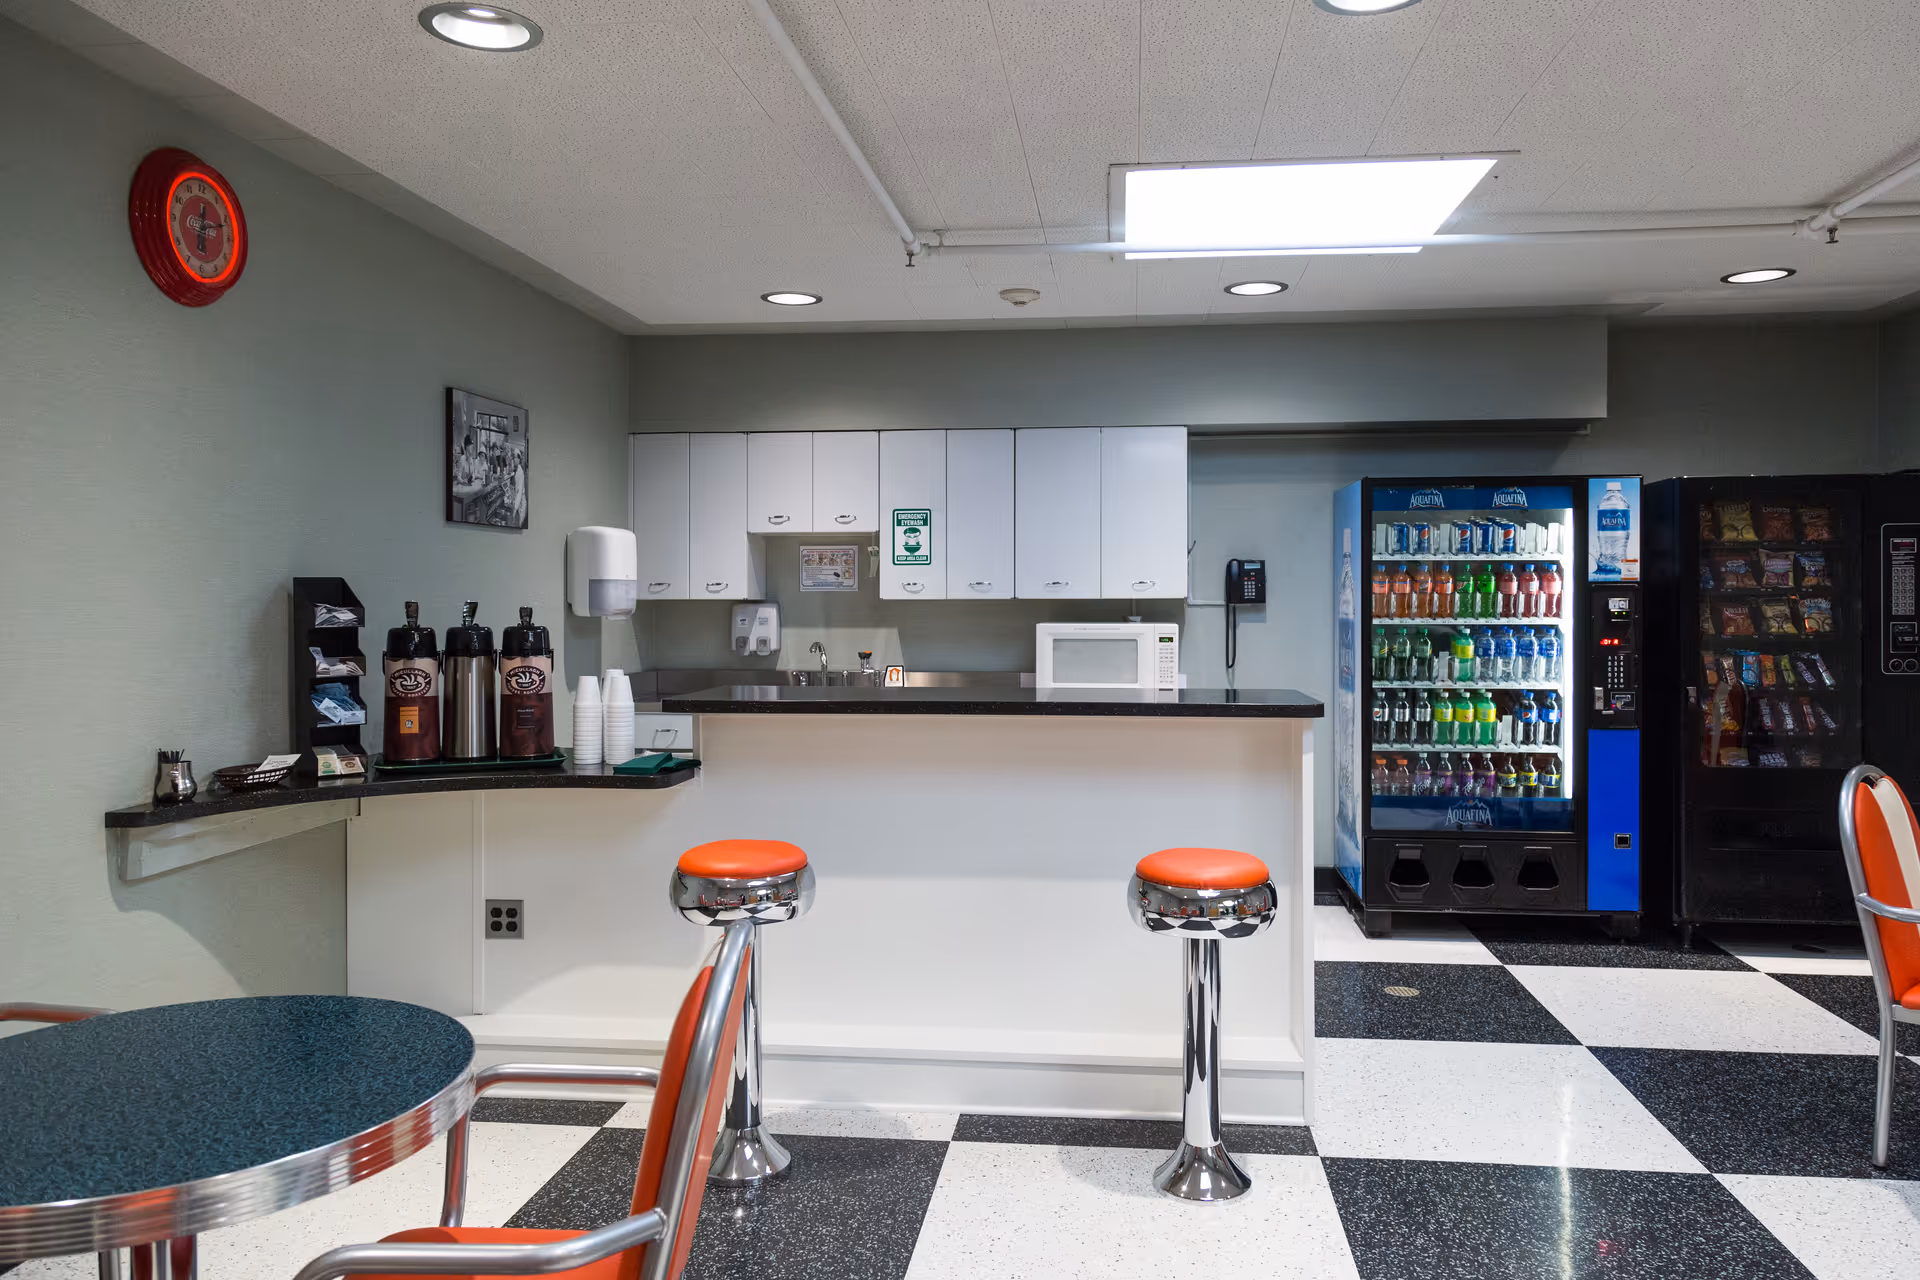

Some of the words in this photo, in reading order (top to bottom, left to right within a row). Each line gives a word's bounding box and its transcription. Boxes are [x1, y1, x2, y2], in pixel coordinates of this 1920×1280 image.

[186, 183, 193, 193] 11
[198, 183, 207, 194] 12
[175, 194, 184, 205] 10
[186, 215, 217, 237] CocaCola
[199, 264, 204, 273] 6
[212, 264, 218, 272] 5
[1409, 493, 1445, 508] AQUAFINA
[1492, 492, 1528, 507] AQUAFINA
[1602, 516, 1626, 526] AQUAFINA
[407, 684, 430, 698] ROASTERS
[523, 682, 544, 695] ROASTERS
[1445, 807, 1492, 827] AQUAFINA
